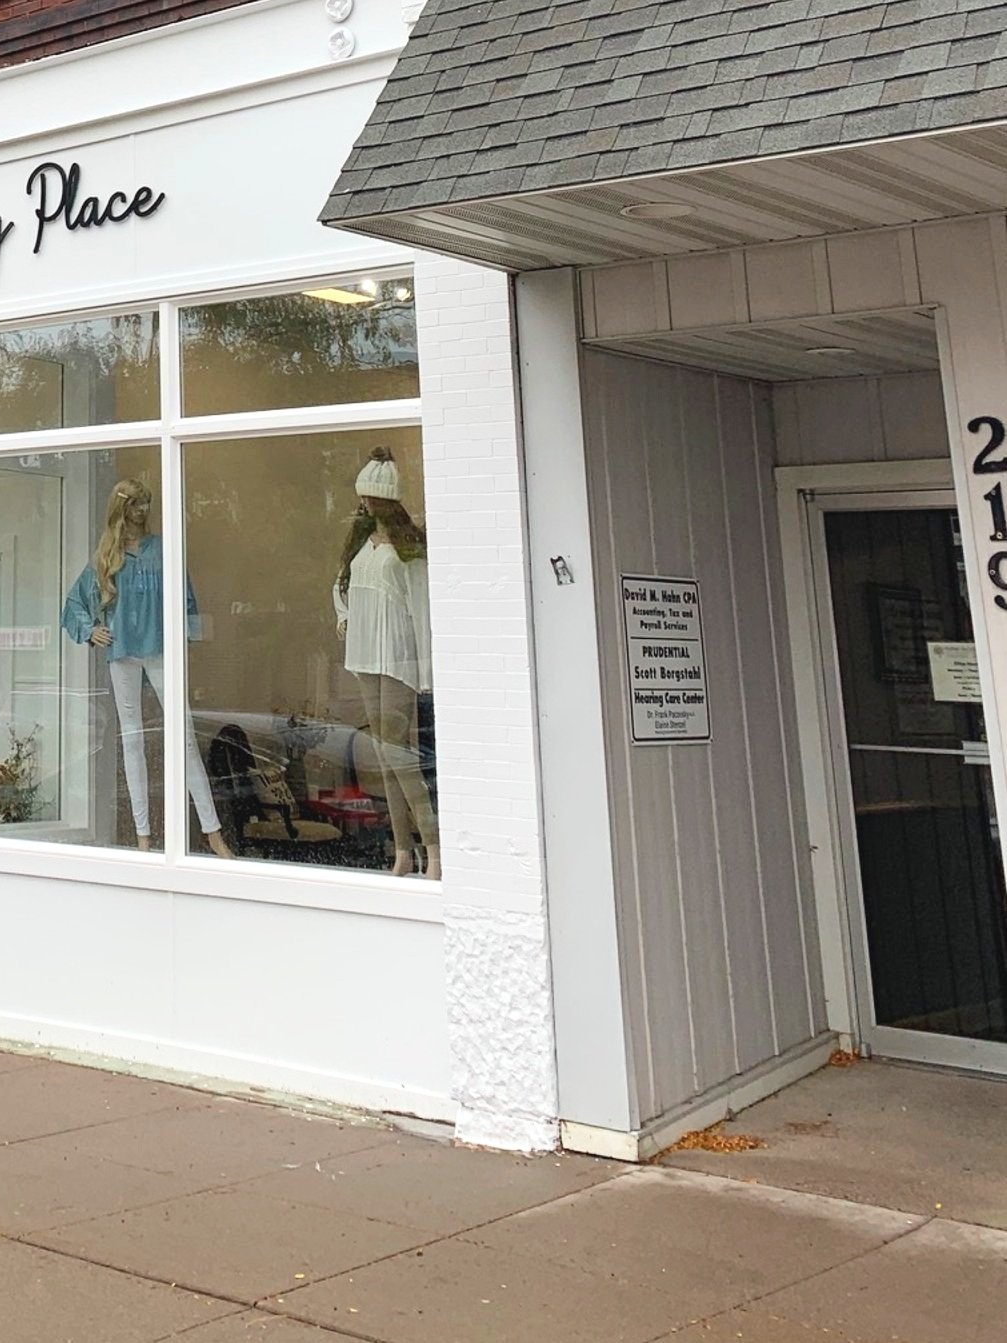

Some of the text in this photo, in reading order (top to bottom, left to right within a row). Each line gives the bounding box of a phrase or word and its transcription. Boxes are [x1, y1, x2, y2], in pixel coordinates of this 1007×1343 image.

[26, 162, 165, 254] Place
[624, 587, 647, 602] David
[649, 589, 660, 602] M.
[683, 591, 697, 604] CPA
[669, 608, 680, 617] Tax
[682, 609, 693, 618] and
[640, 620, 688, 631] Payroll Services
[642, 645, 690, 658] PRUDENTIAL
[634, 666, 656, 679] Scott
[634, 691, 704, 707] Hearing Care Center
